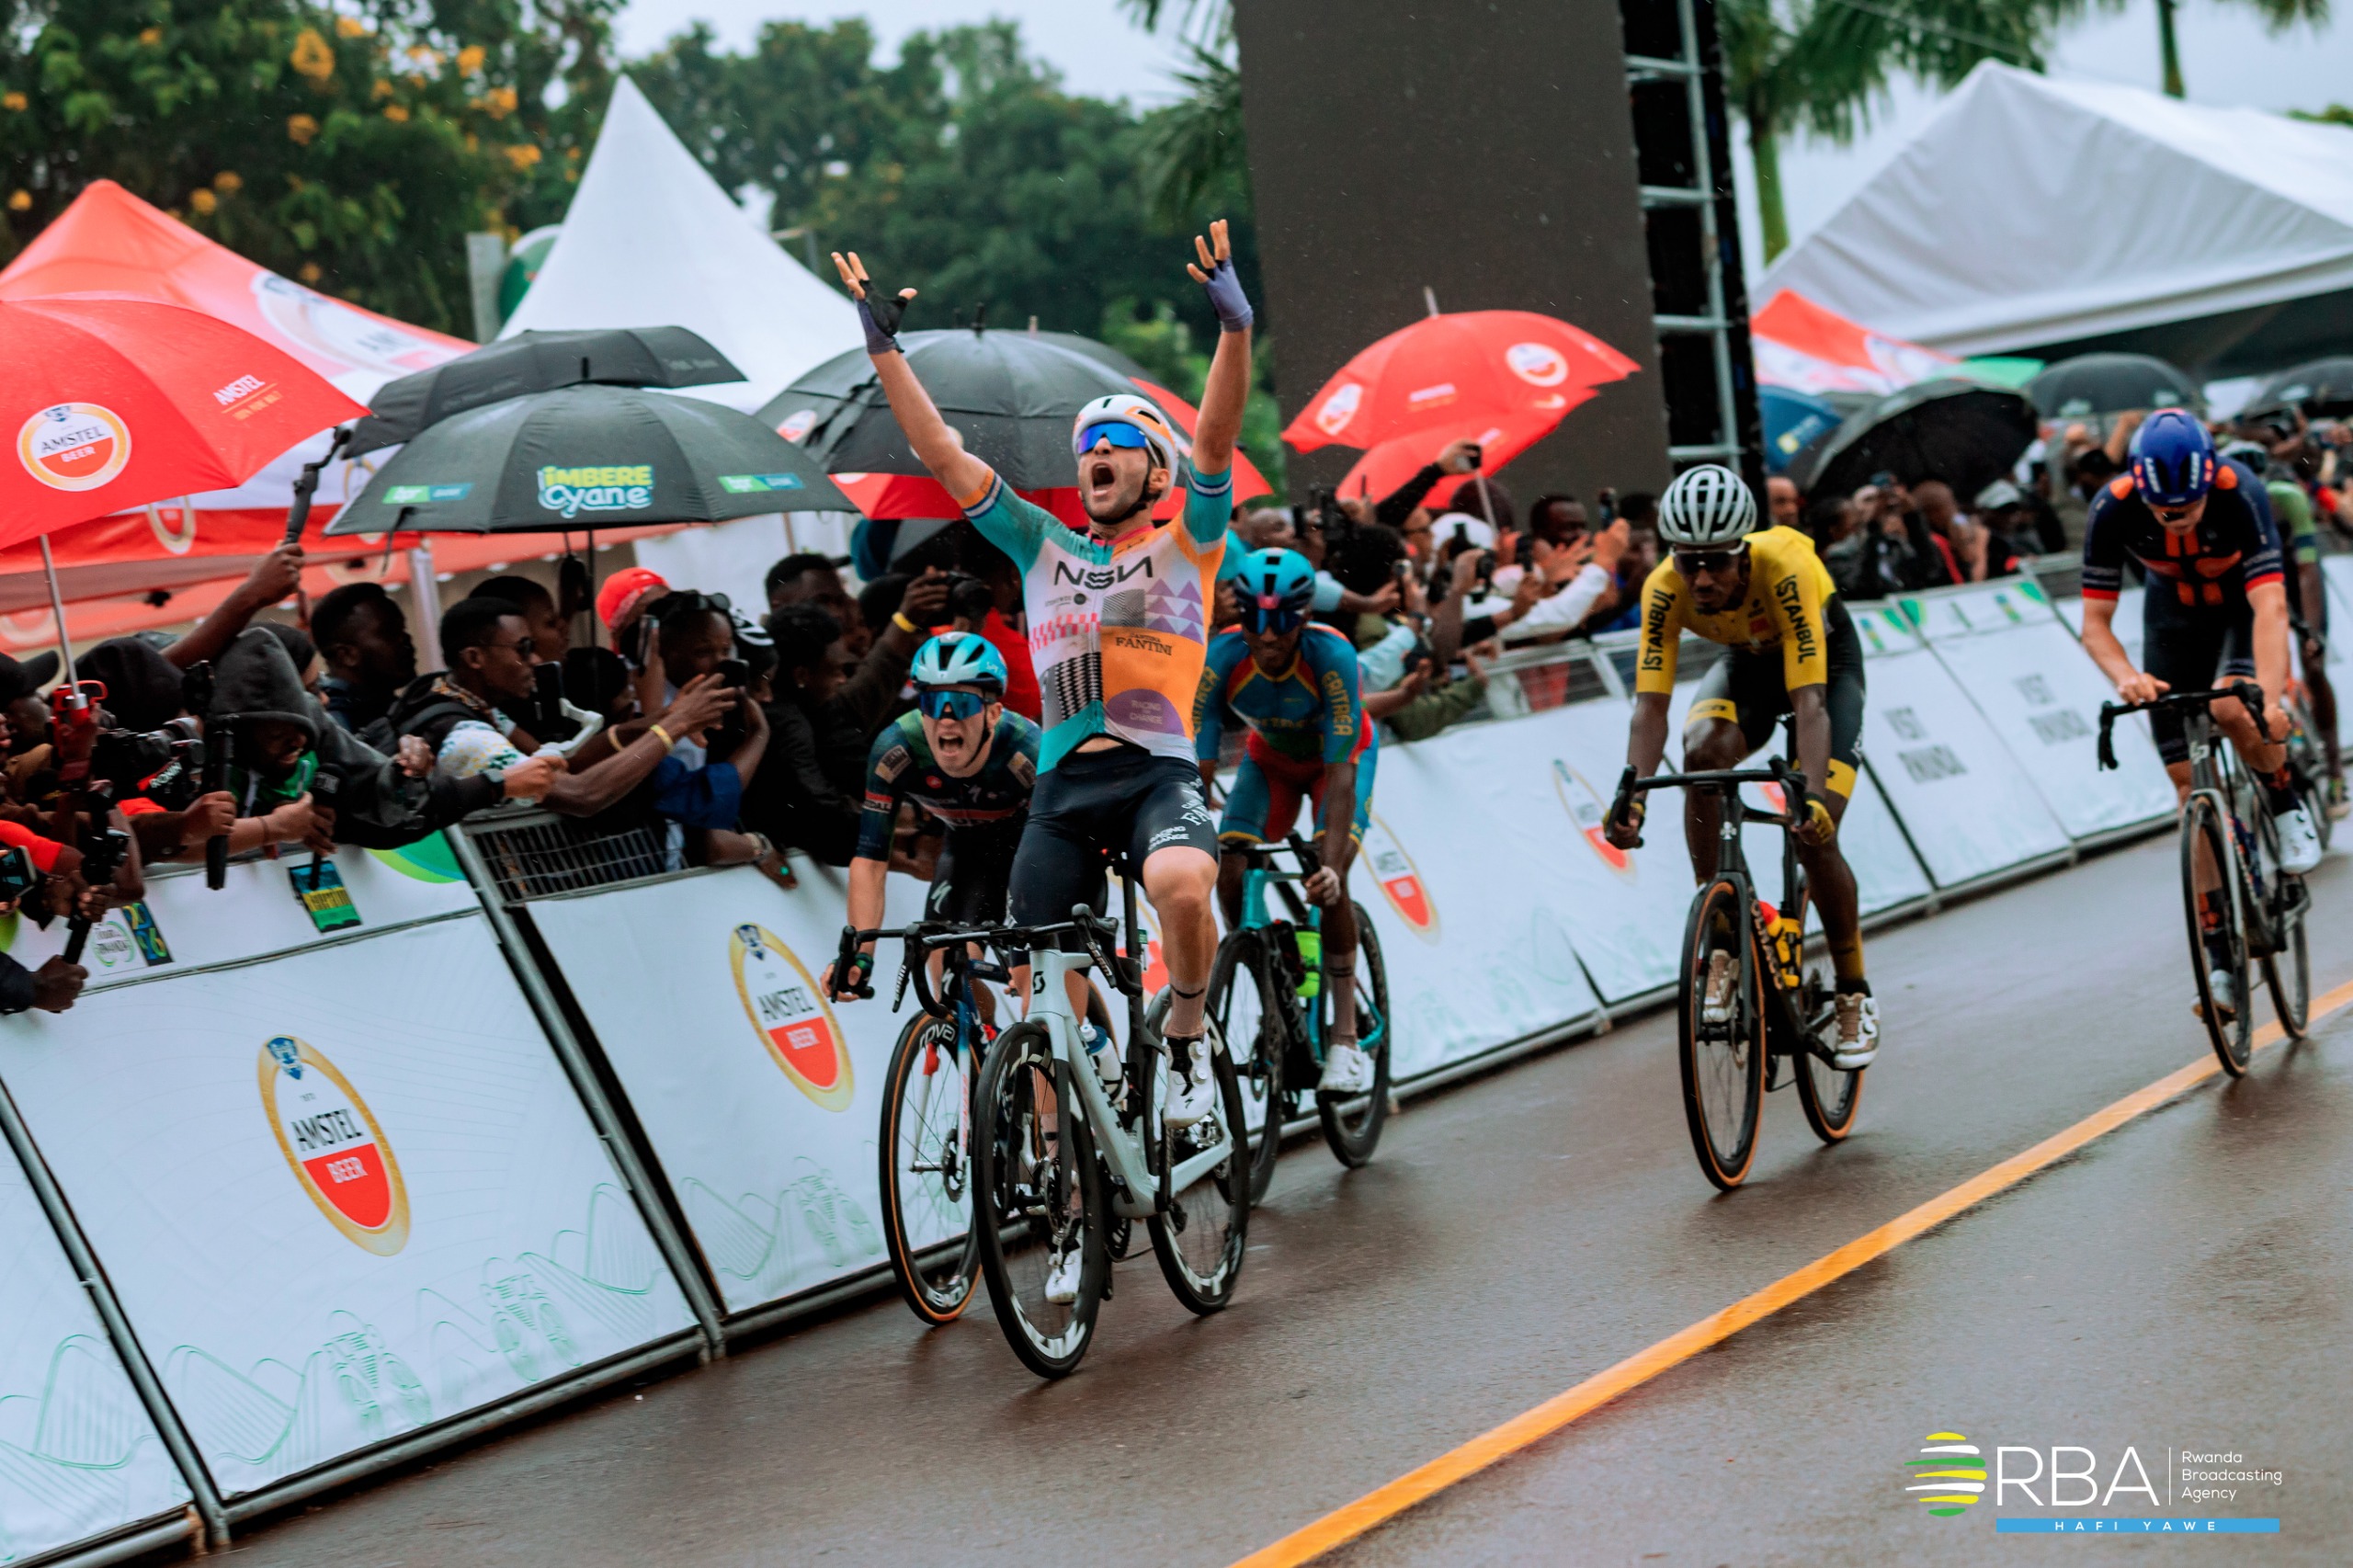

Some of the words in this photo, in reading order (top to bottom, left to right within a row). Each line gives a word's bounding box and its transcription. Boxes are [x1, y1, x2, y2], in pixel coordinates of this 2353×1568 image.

[212, 374, 266, 405] AMSTEL
[40, 426, 106, 453] AMSTEL
[60, 446, 96, 462] BEER
[545, 484, 649, 513] Cyane
[1115, 636, 1173, 656] FANTINI
[757, 986, 816, 1021] AMSTEL
[290, 1108, 364, 1152] AMSTEL
[325, 1156, 369, 1184] BEER
